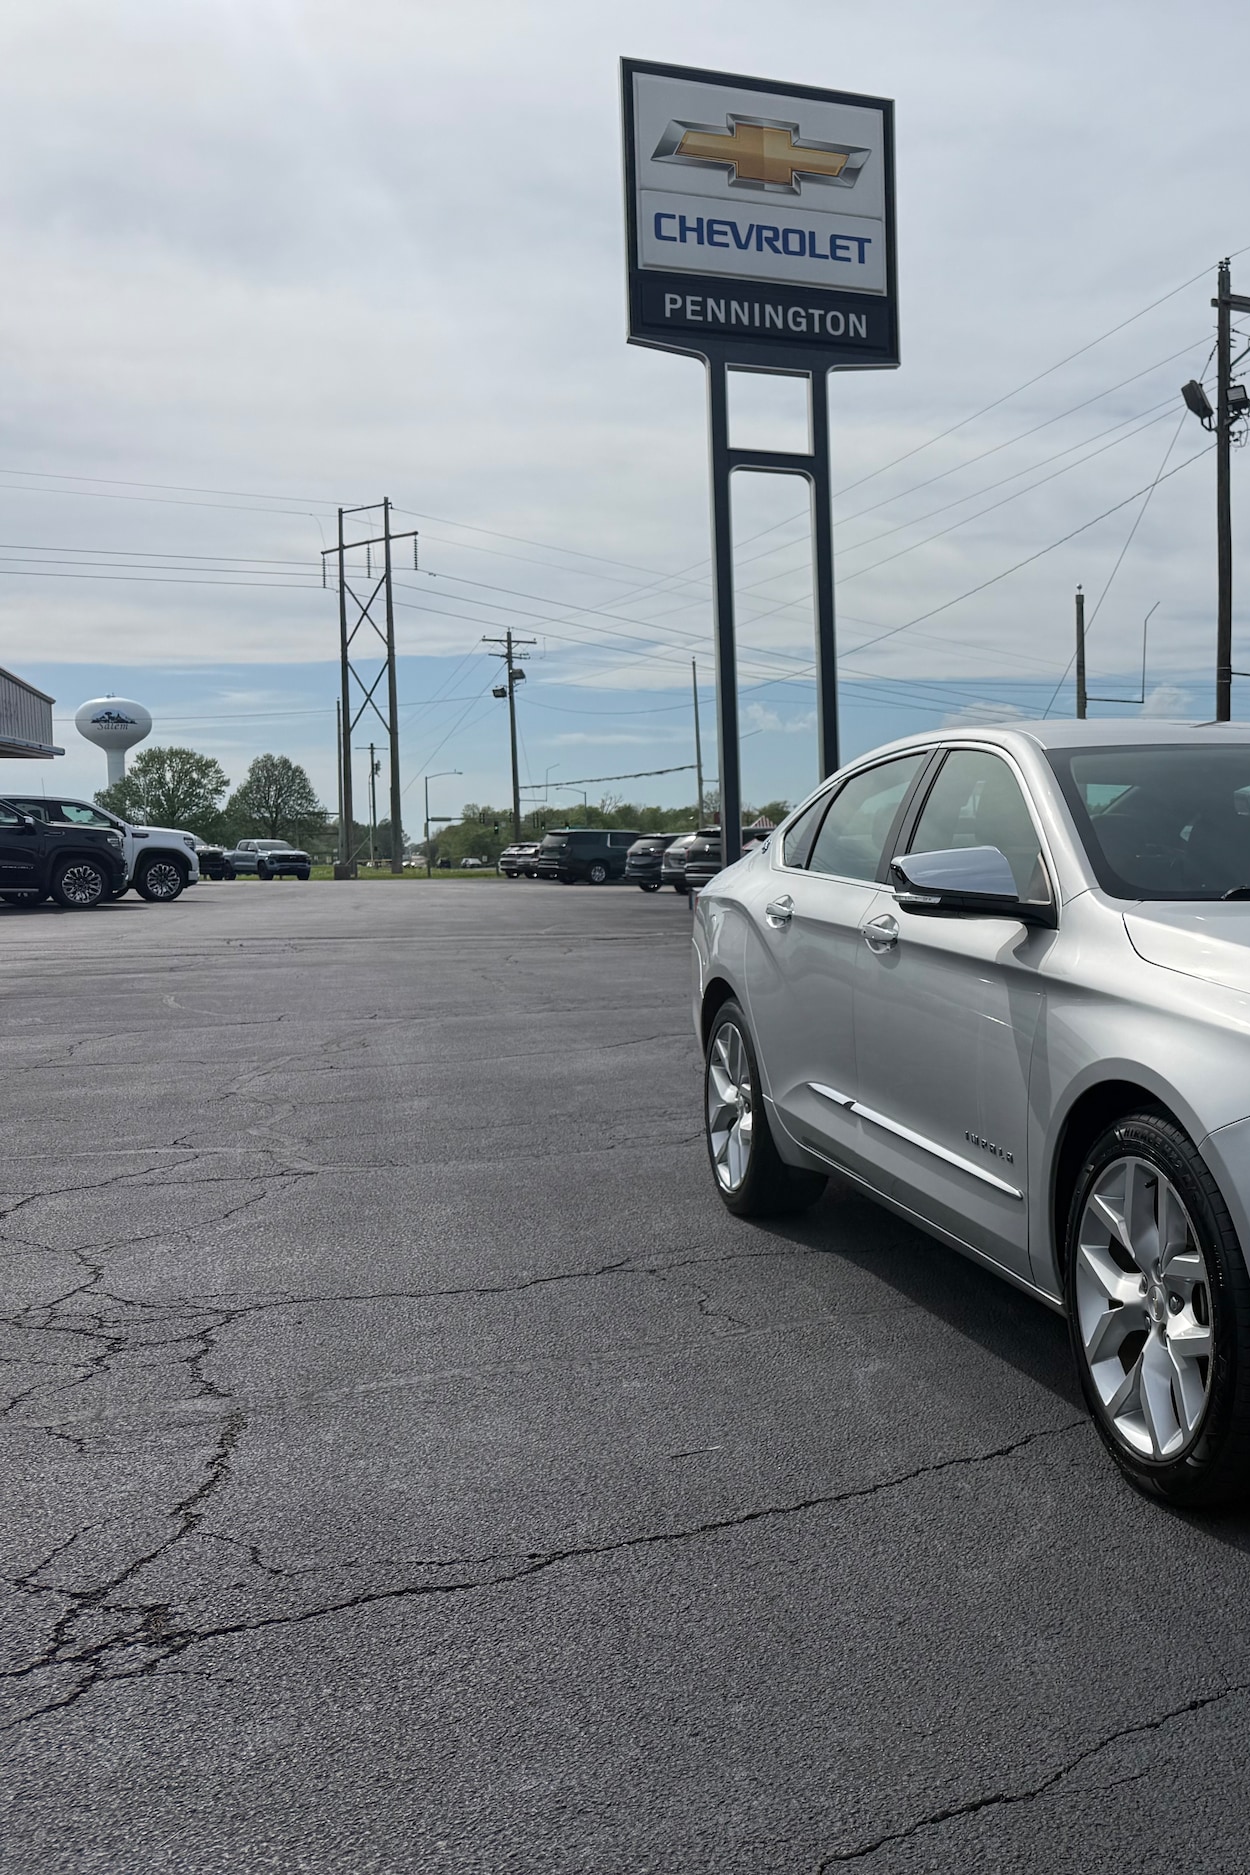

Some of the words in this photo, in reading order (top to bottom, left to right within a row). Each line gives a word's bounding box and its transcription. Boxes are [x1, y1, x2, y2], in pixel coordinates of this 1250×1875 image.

[654, 212, 872, 265] CHEVROLET
[664, 293, 868, 339] PENNINGTON
[97, 722, 129, 731] Salem
